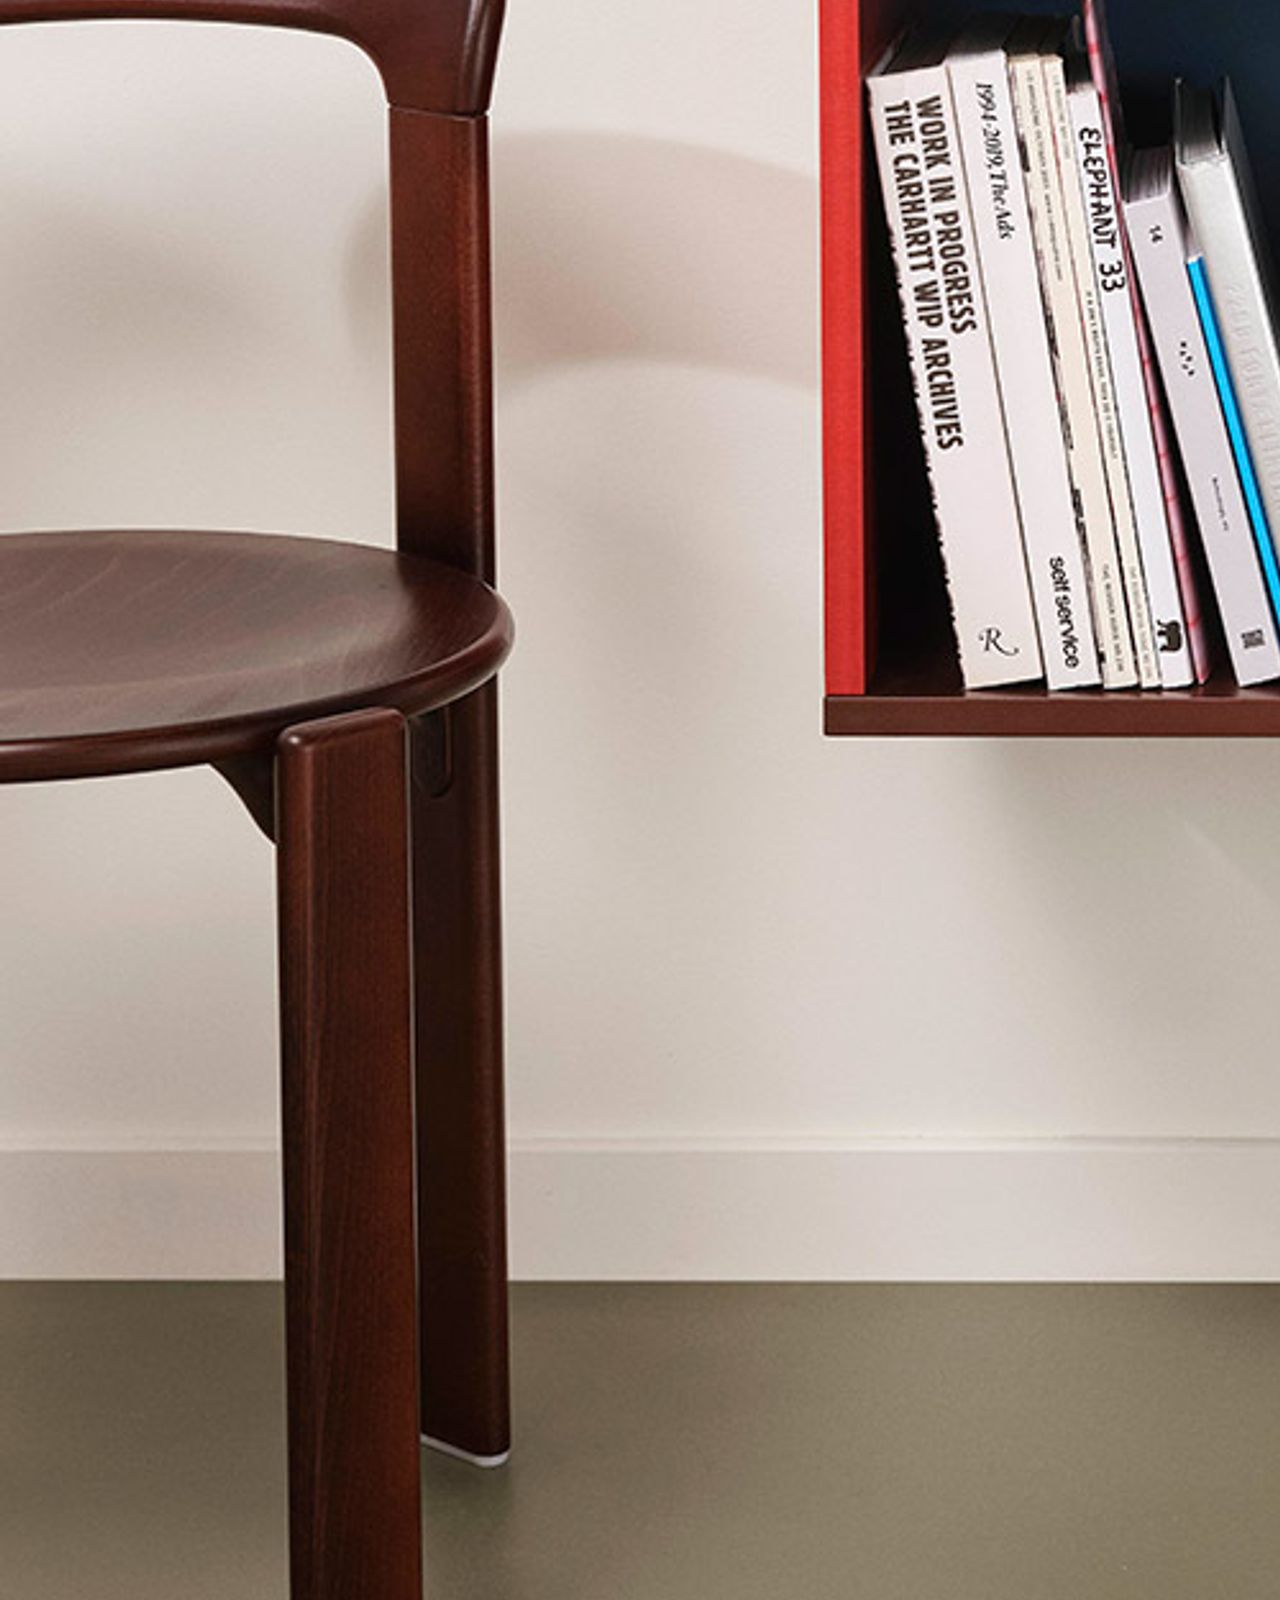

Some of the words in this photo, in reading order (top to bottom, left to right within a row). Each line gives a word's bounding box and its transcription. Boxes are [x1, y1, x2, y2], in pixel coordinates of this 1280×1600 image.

[884, 100, 916, 146] THE
[916, 95, 951, 171] WORK
[892, 153, 936, 273] CARHARTT
[928, 175, 956, 204] IN
[994, 206, 1016, 240] Ads
[1078, 127, 1118, 250] ELEPHANT
[1099, 260, 1126, 293] 33
[913, 279, 944, 329] WIP
[935, 209, 977, 335] PROGRESS
[921, 338, 964, 451] ARCHIVES
[1049, 555, 1071, 592] self
[1055, 594, 1080, 669] service
